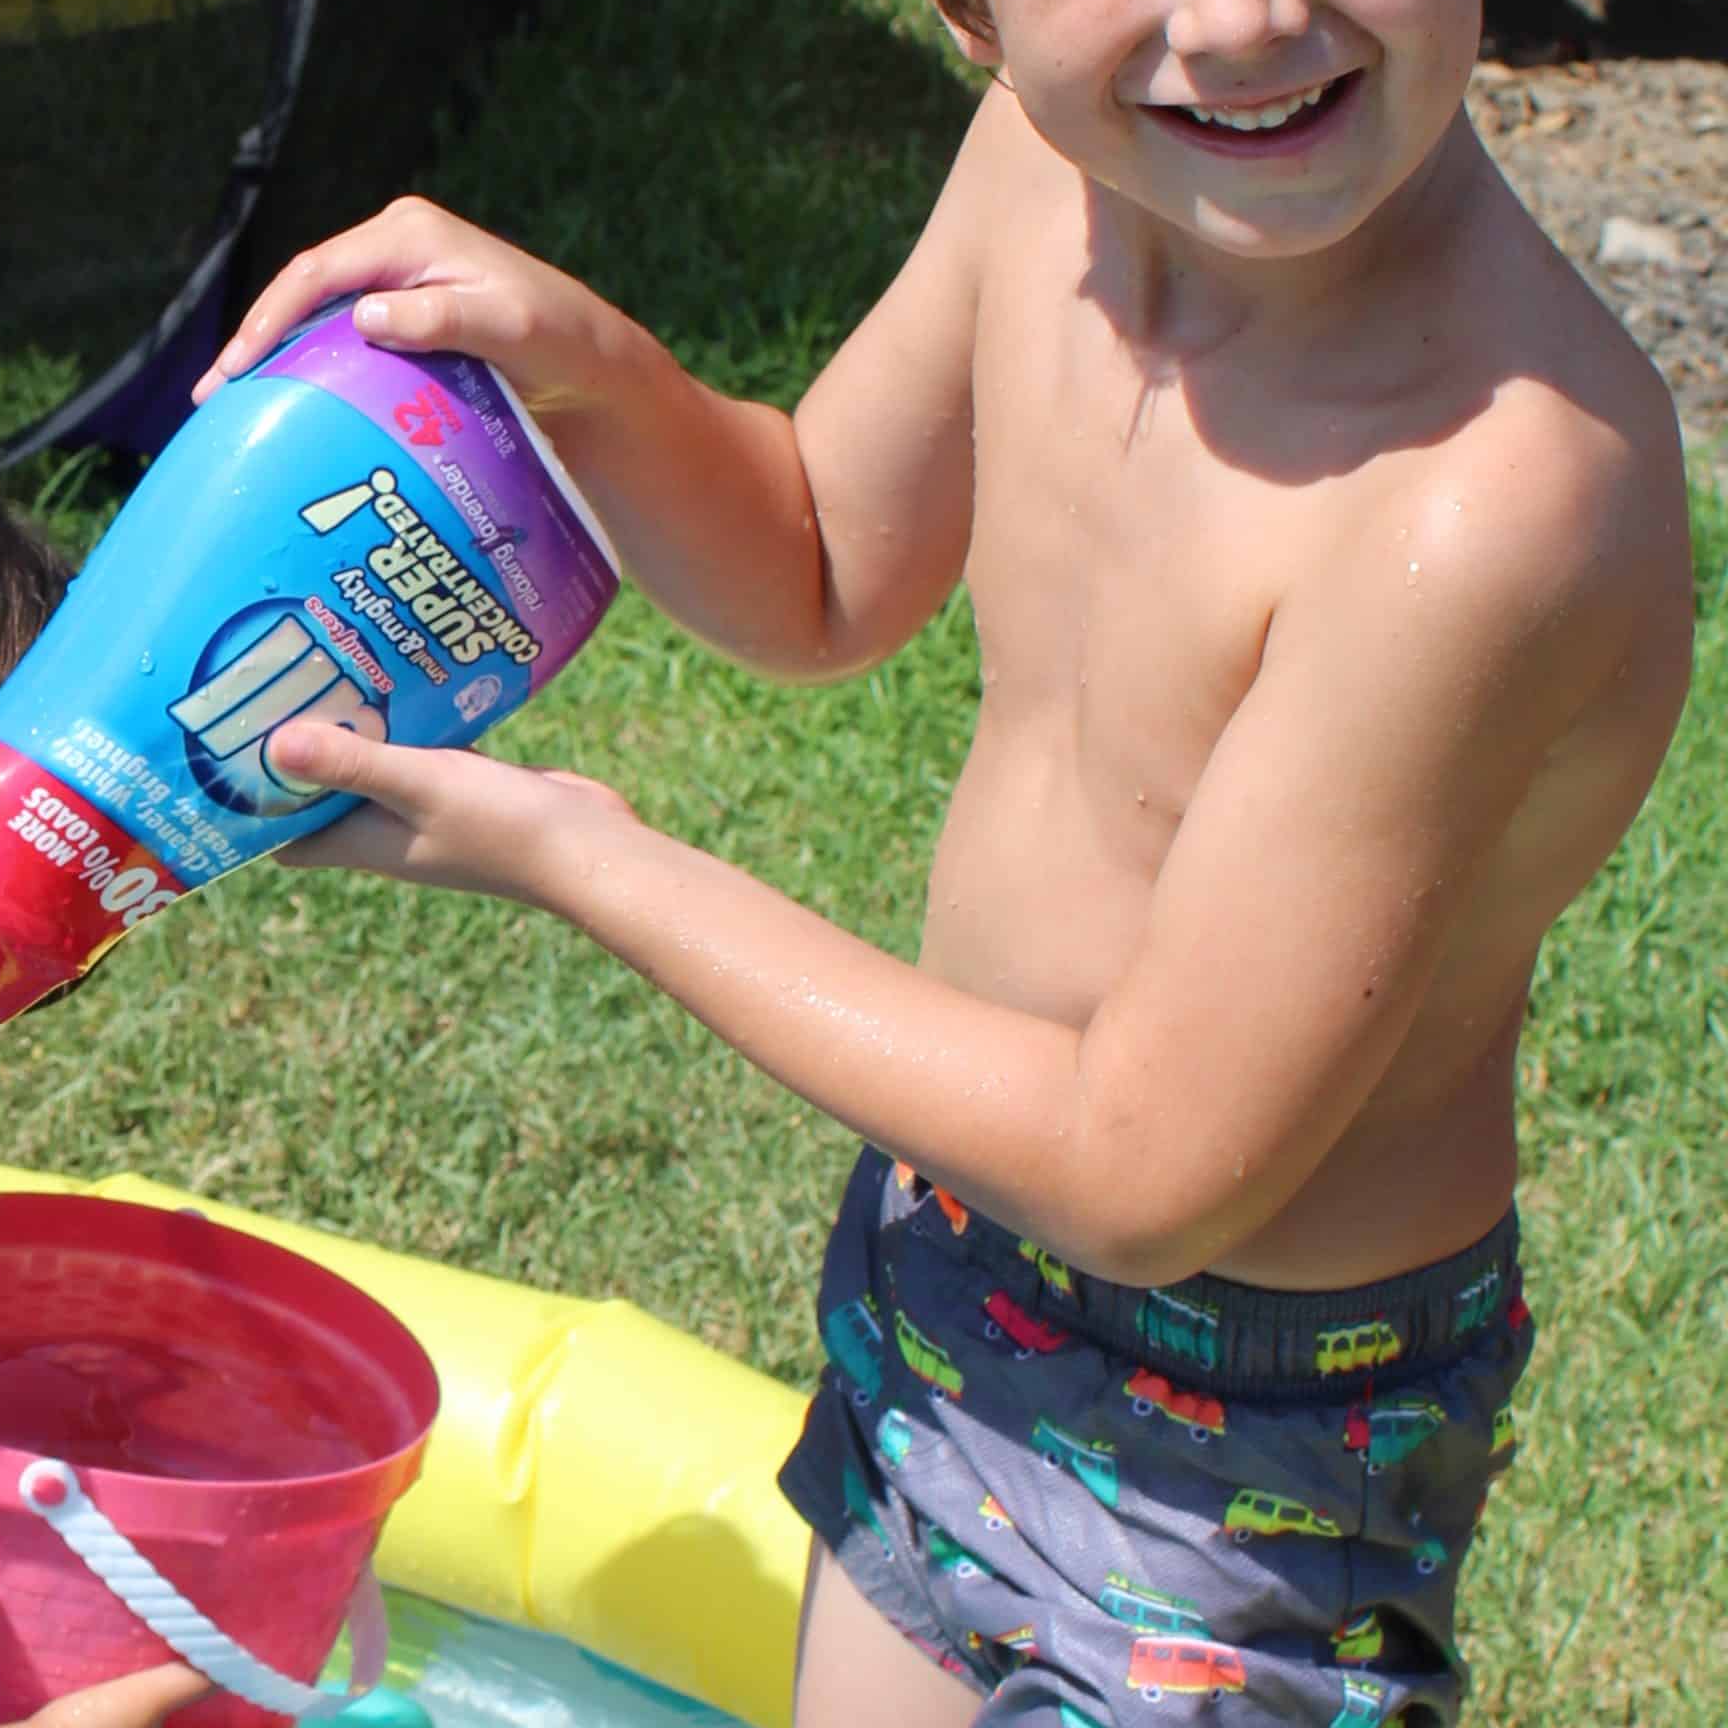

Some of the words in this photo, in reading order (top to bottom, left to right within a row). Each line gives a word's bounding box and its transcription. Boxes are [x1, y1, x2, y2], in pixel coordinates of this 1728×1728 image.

[393, 388, 446, 447] 42
[366, 536, 496, 664] SUPER
[493, 542, 545, 613] relaxing
[303, 595, 394, 694] stainlifters
[8, 809, 79, 867] MORE
[22, 787, 100, 849] LOADS
